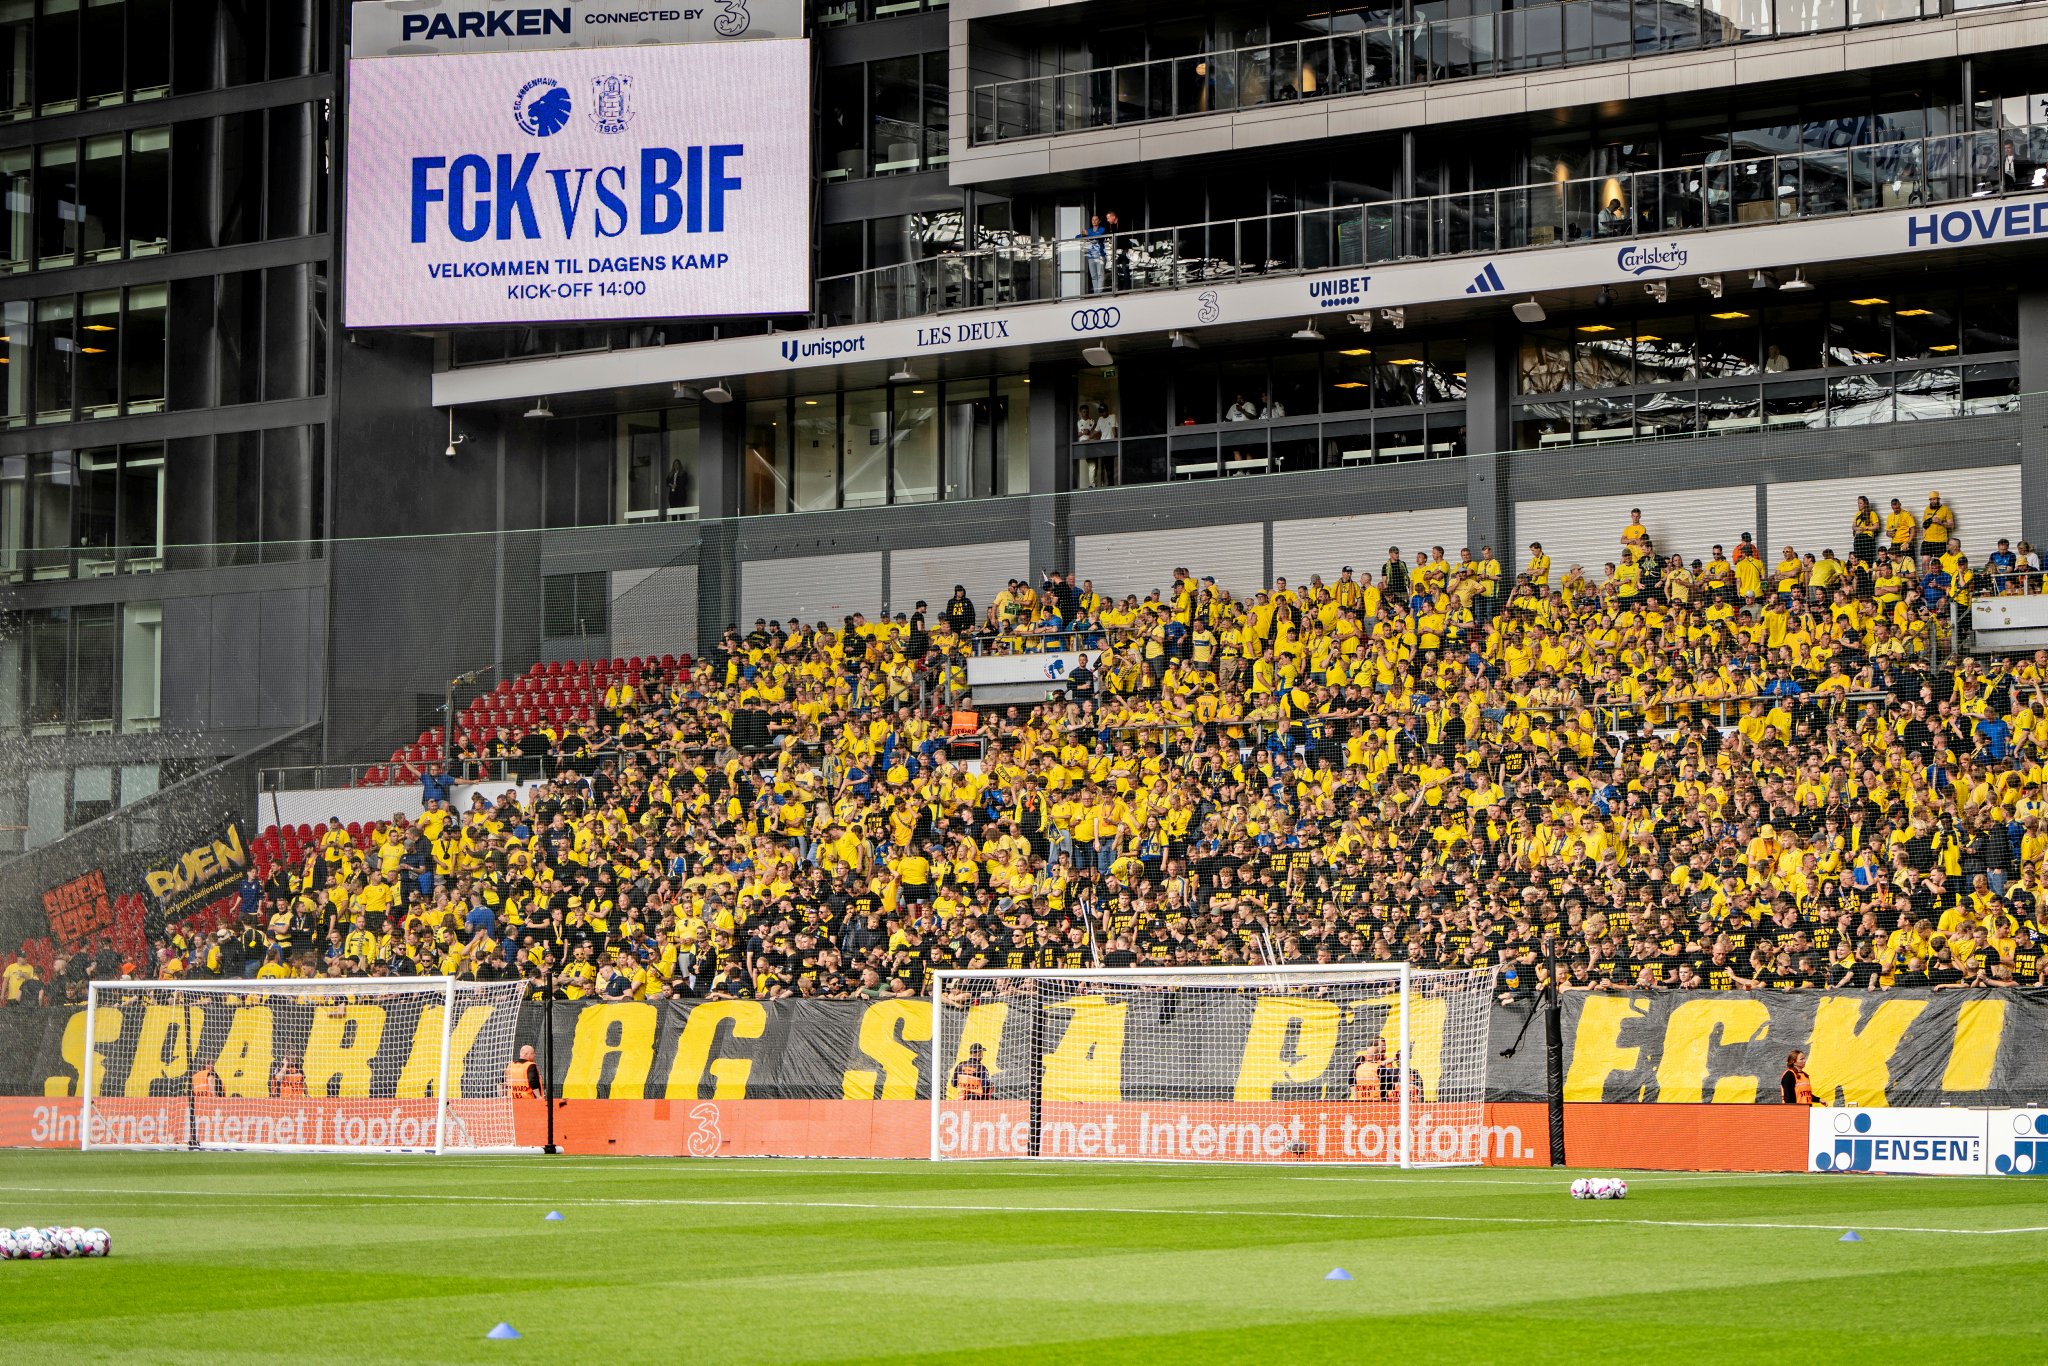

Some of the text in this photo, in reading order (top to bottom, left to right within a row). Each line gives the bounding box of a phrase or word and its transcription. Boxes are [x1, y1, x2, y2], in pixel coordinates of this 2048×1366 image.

[402, 8, 572, 41] PARKEN
[585, 11, 681, 25] CONNECTED
[684, 9, 704, 21] BY
[599, 124, 625, 133] 1964
[411, 149, 541, 244] FCK
[639, 143, 743, 236] BIF
[428, 253, 729, 279] VELKOMMEN TIL DAGENS KAMP
[1617, 243, 1688, 275] Carlsberg
[507, 280, 647, 300] KICK-OFF 14:00
[1309, 276, 1371, 298] UNIBET
[801, 334, 869, 359] unisport
[917, 320, 1010, 347] LES DEUX
[951, 728, 977, 736] STEWARD
[44, 1004, 493, 1100] SPARK
[939, 1110, 1535, 1166] 3Internet. Internet i topform.
